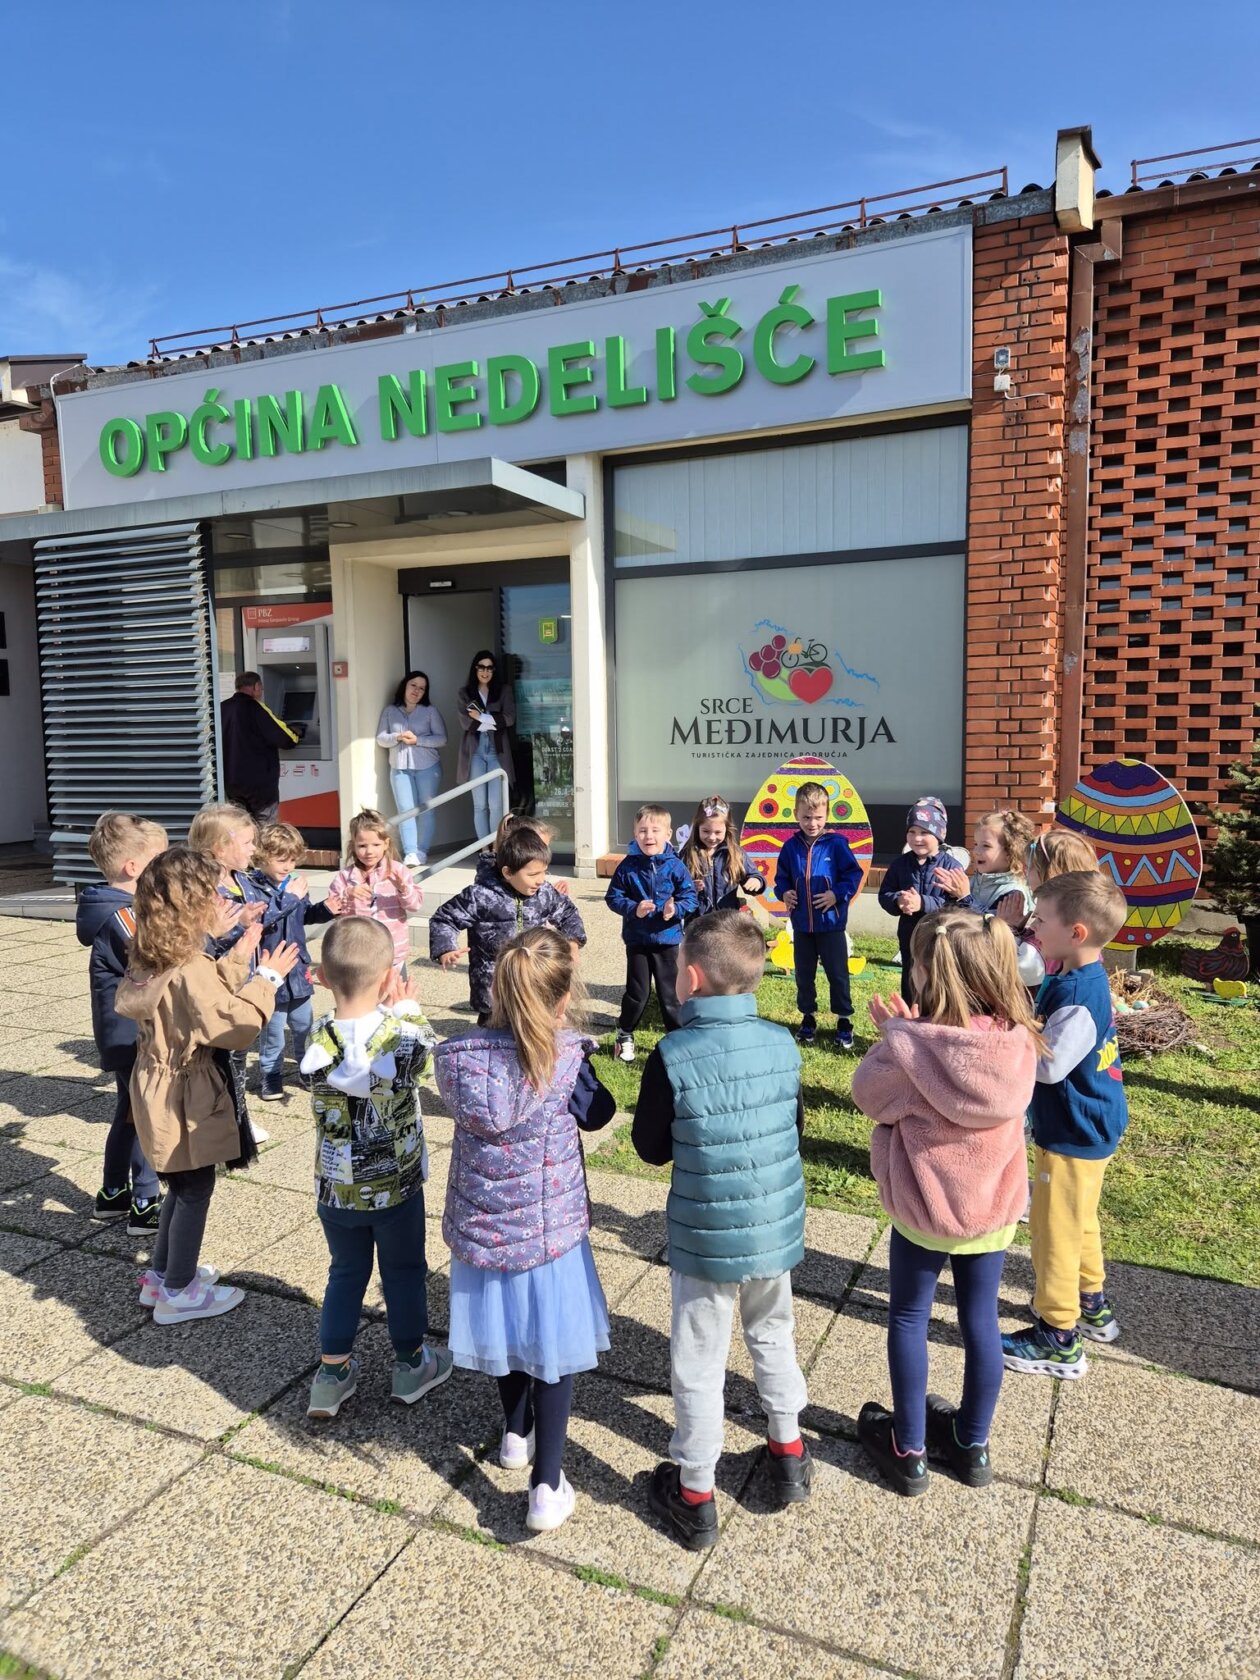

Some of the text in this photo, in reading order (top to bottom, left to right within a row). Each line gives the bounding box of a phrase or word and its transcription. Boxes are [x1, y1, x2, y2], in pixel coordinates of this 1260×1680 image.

[100, 284, 886, 478] OPĆINA NEDELIŠĆE
[258, 608, 272, 617] PBZ
[700, 697, 753, 715] SRCE
[669, 715, 898, 751] MEĐIMURJA
